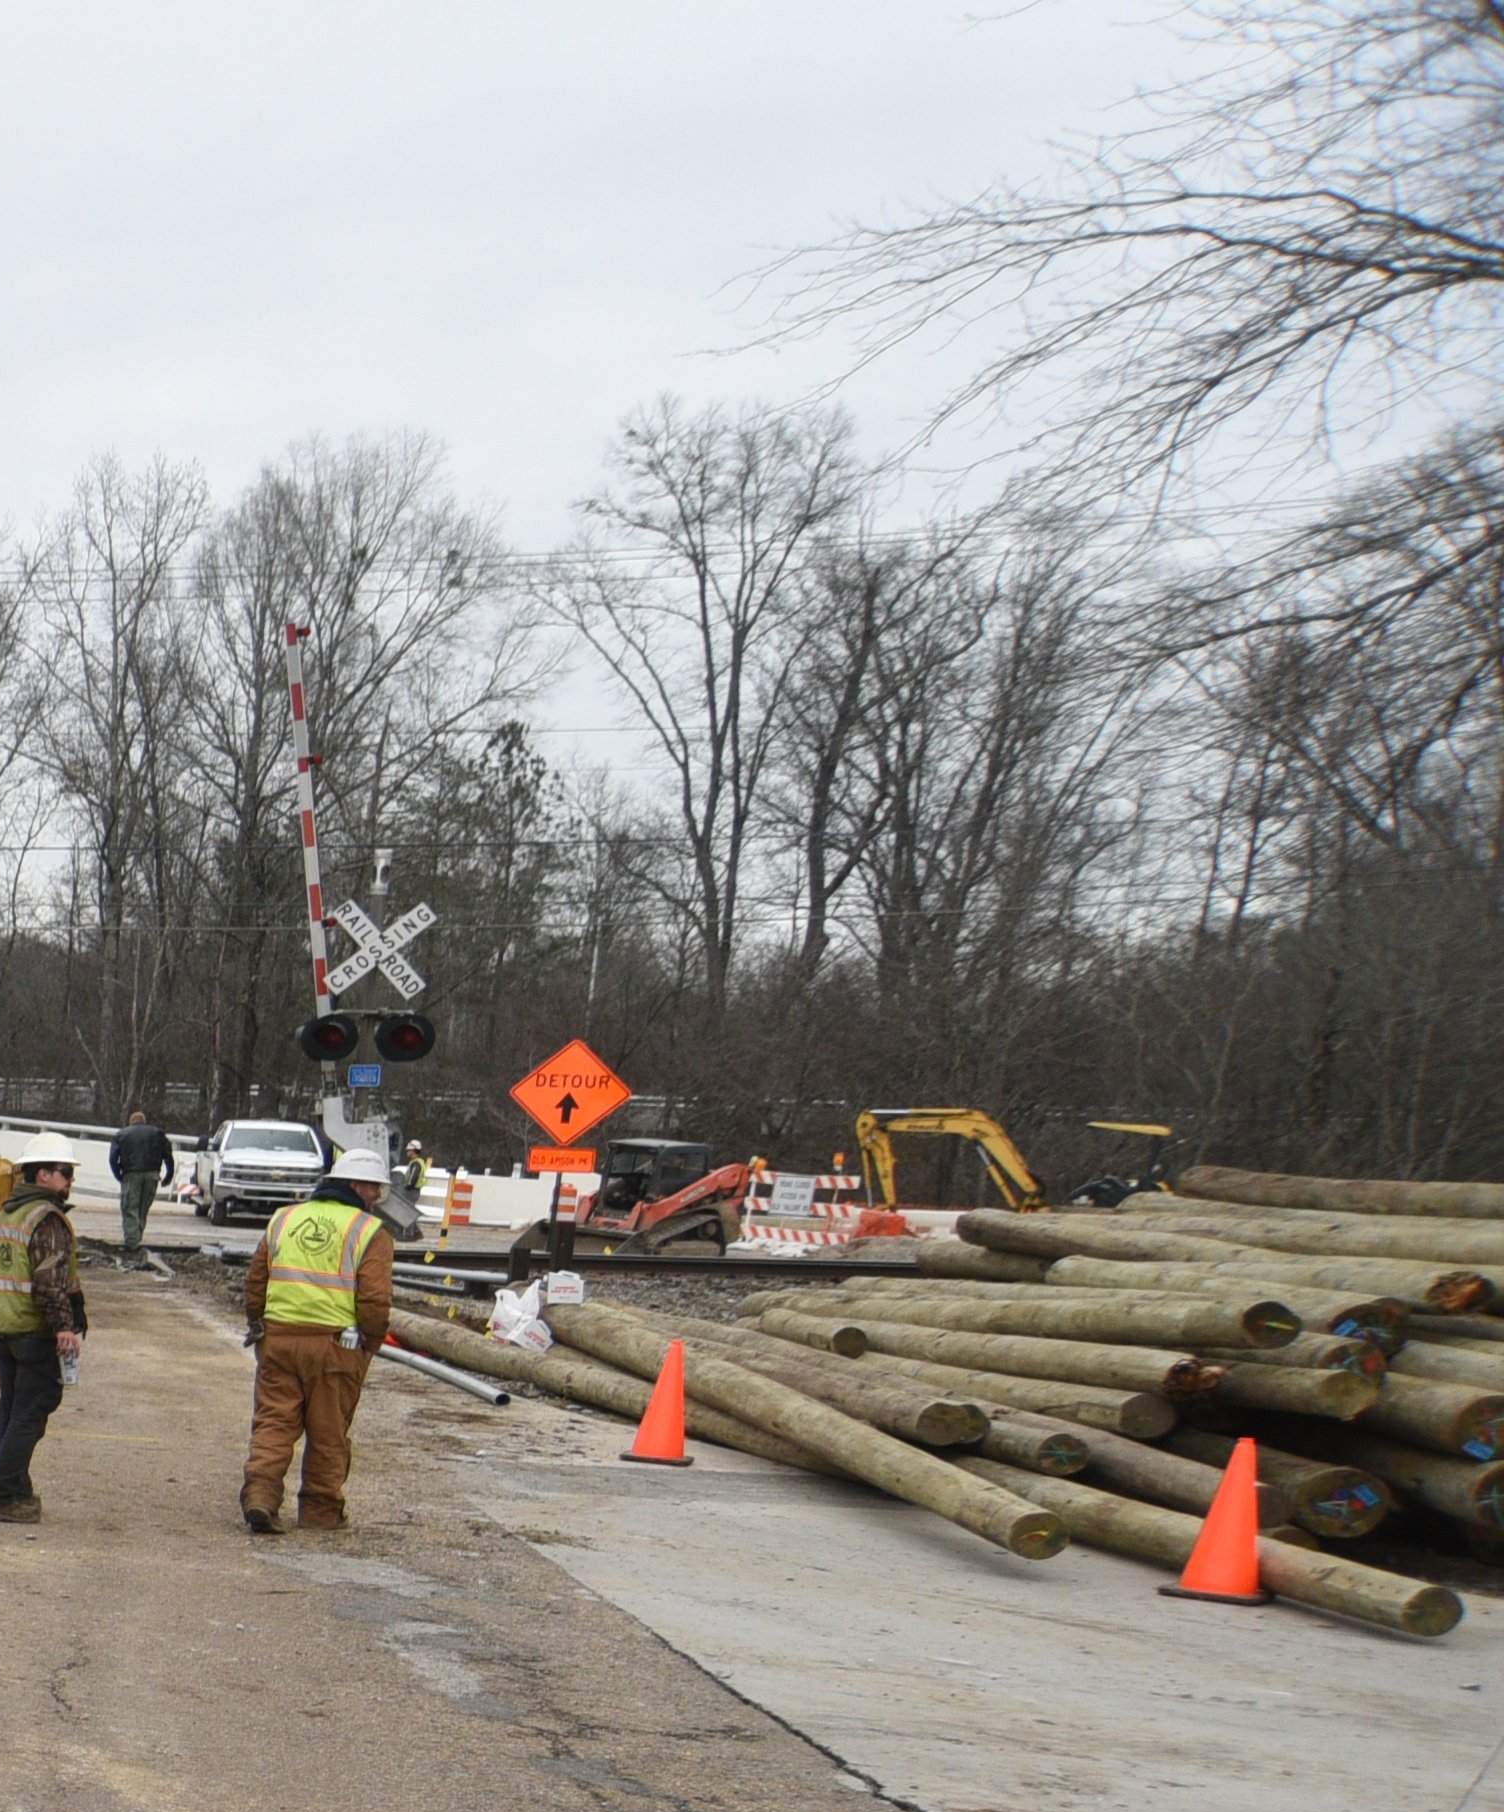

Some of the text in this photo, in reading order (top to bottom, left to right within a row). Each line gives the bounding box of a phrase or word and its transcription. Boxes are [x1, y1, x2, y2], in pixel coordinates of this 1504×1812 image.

[330, 908, 431, 989] CROSSING
[535, 1073, 610, 1089] DETOUR
[531, 1155, 546, 1165] OLD
